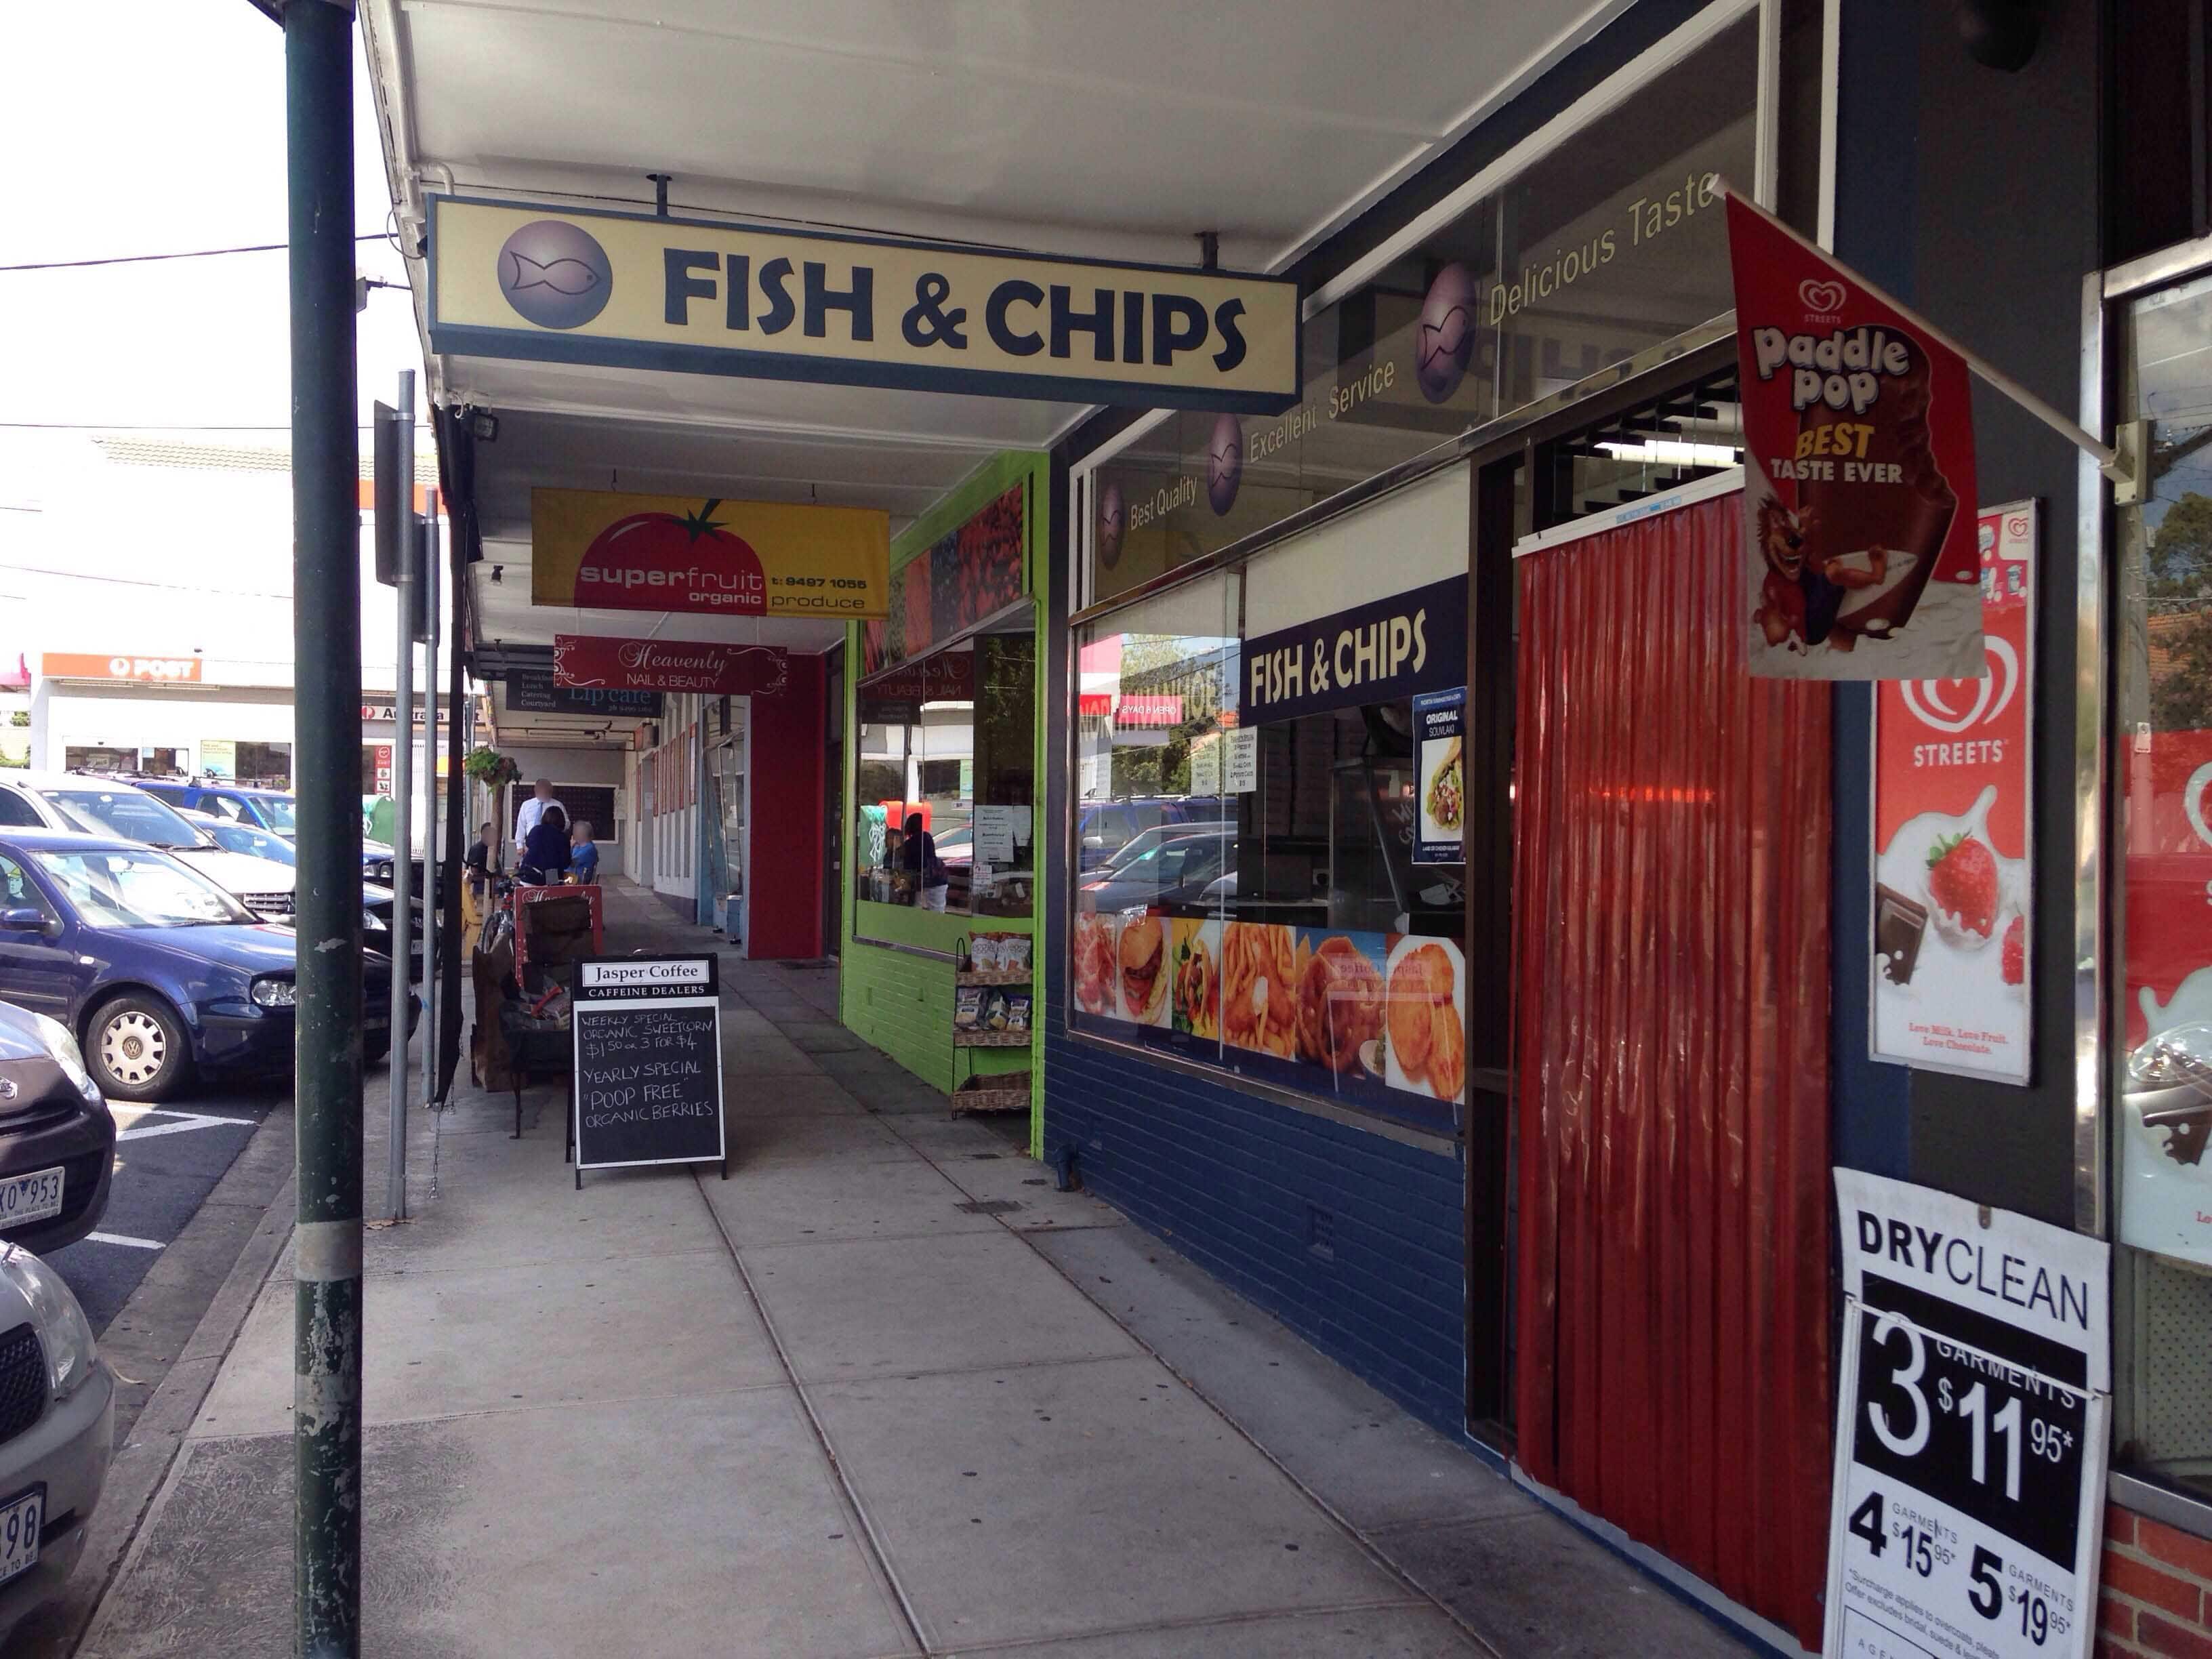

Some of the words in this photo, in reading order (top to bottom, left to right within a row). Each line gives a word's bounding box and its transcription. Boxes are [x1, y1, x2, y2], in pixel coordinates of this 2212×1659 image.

[1490, 226, 1616, 326] Delicious
[1627, 171, 1715, 246] Taste
[662, 247, 875, 342] FISH
[901, 272, 968, 350] &
[985, 279, 1248, 372] CHIPS
[1804, 314, 1842, 325] STREETS
[1249, 404, 1317, 462] Excellent
[1328, 359, 1394, 417] Service
[1795, 422, 1875, 461] BEST
[1771, 458, 1835, 483] TASTE
[1844, 459, 1902, 484] EVER
[1130, 496, 1153, 531] Best
[1158, 475, 1198, 518] Quality
[580, 566, 762, 590] superfruit
[785, 577, 826, 588] 9497
[689, 592, 762, 605] organic
[771, 595, 865, 609] produce
[134, 659, 194, 678] POST
[618, 642, 728, 675] Heavenly
[1250, 643, 1304, 706] FISH
[1310, 637, 1330, 694] &
[1334, 608, 1427, 689] CHIPS
[627, 673, 654, 685] NAIL
[657, 675, 667, 686] &
[669, 676, 718, 689] BEAUTY
[521, 699, 556, 708] Courtyard
[1426, 710, 1458, 724] ORIGINAL
[1429, 724, 1454, 737] SOUVLAKI
[1912, 740, 2004, 767] STREETS
[595, 966, 645, 982] Jasper
[649, 964, 698, 978] Coffee
[589, 987, 647, 998] CAFFEINE
[652, 985, 705, 995] DEALERS
[581, 1016, 628, 1027] WEEKLY
[634, 1013, 678, 1024] SPECIAL
[583, 1025, 638, 1040] ORGANIC
[642, 1020, 713, 1035] SWEETCORN
[640, 1038, 650, 1049] 3
[655, 1038, 674, 1048] FOR
[676, 1033, 697, 1050] $4
[583, 1065, 640, 1084] YEARLY
[644, 1061, 701, 1077] SPECIAL
[586, 1107, 648, 1128] ORGANIC
[652, 1101, 713, 1120] BERRIES
[30, 1176, 59, 1204] 953
[1858, 1210, 2089, 1330] DRYCLEAN
[1868, 1312, 1931, 1457] 3
[1849, 1490, 1887, 1558] 4
[1892, 1502, 1958, 1544] GARMENTS
[1968, 1543, 2003, 1620] 5
[2009, 1564, 2074, 1612] GARMENTS
